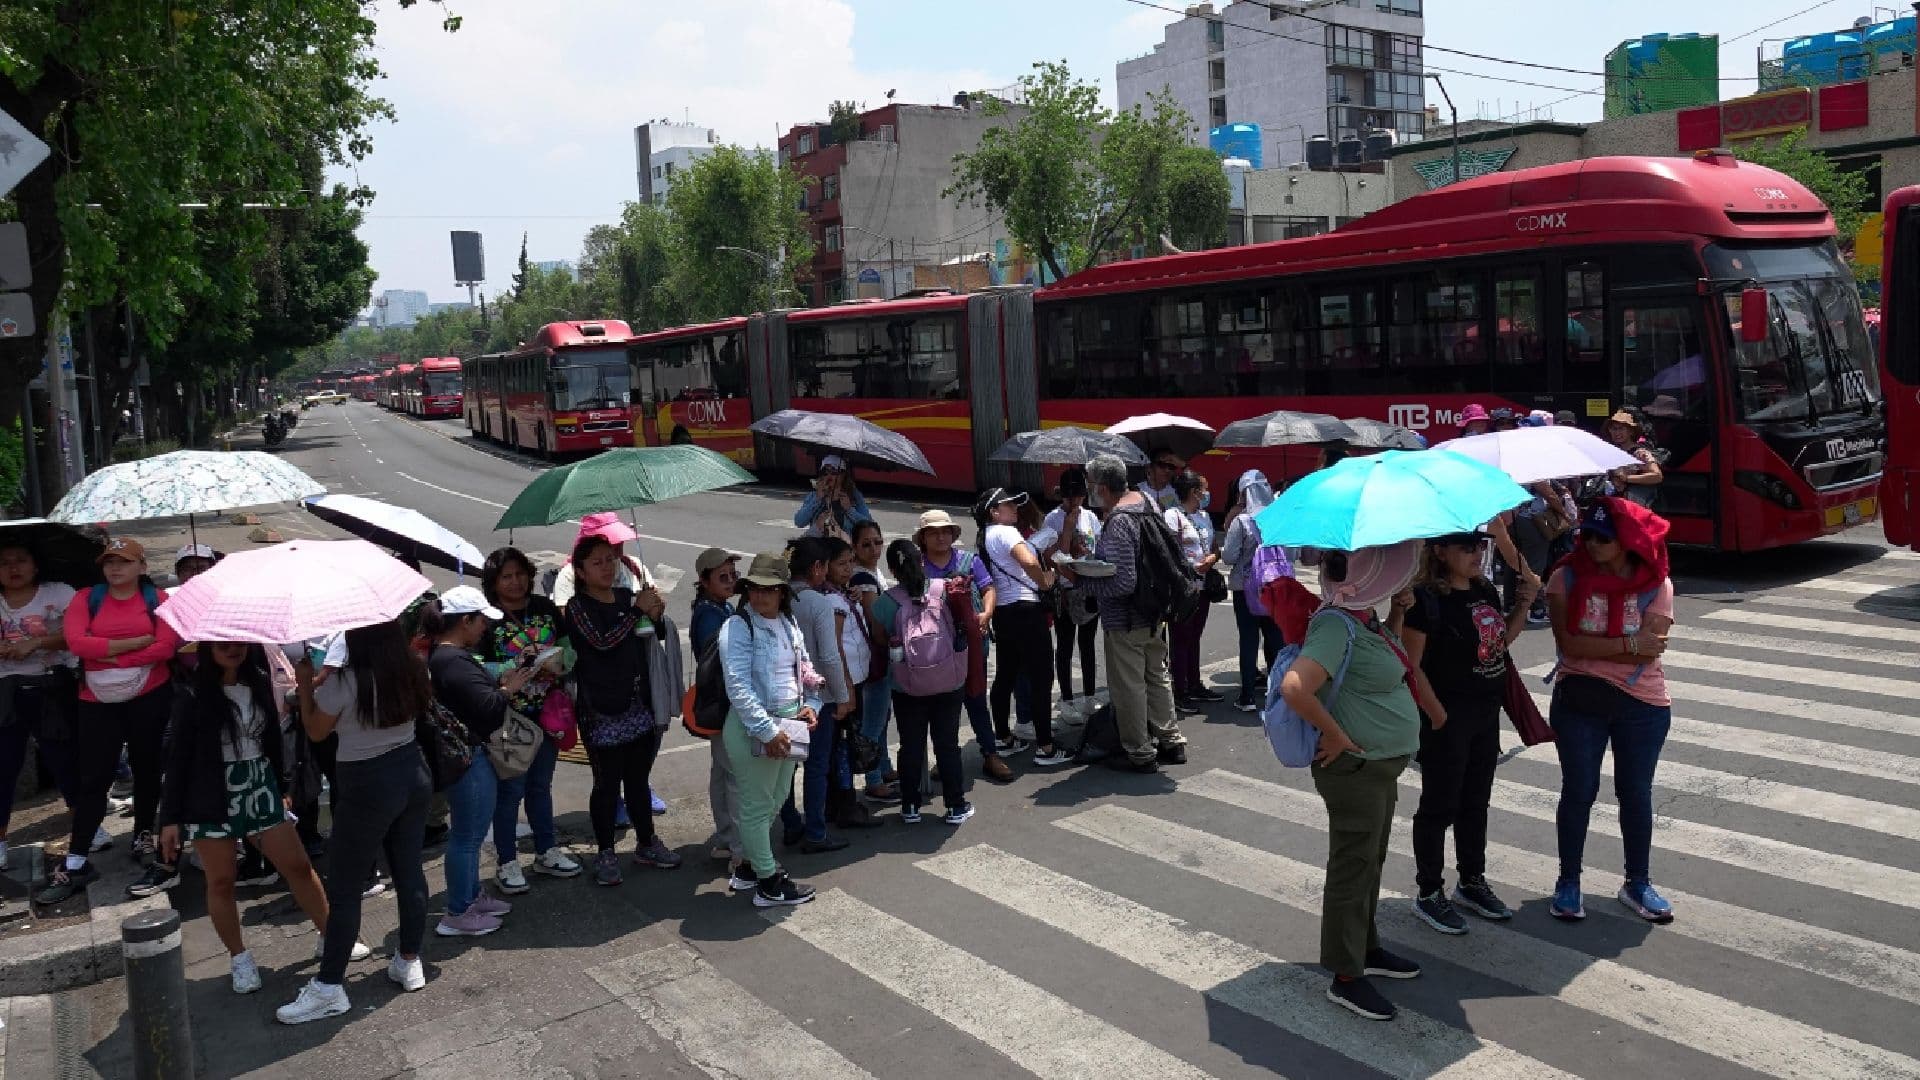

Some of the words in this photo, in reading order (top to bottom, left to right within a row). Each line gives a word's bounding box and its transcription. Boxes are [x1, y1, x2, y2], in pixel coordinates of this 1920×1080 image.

[1753, 187, 1789, 200] CDMX
[1516, 212, 1567, 231] CDMX
[687, 400, 726, 422] CDMX
